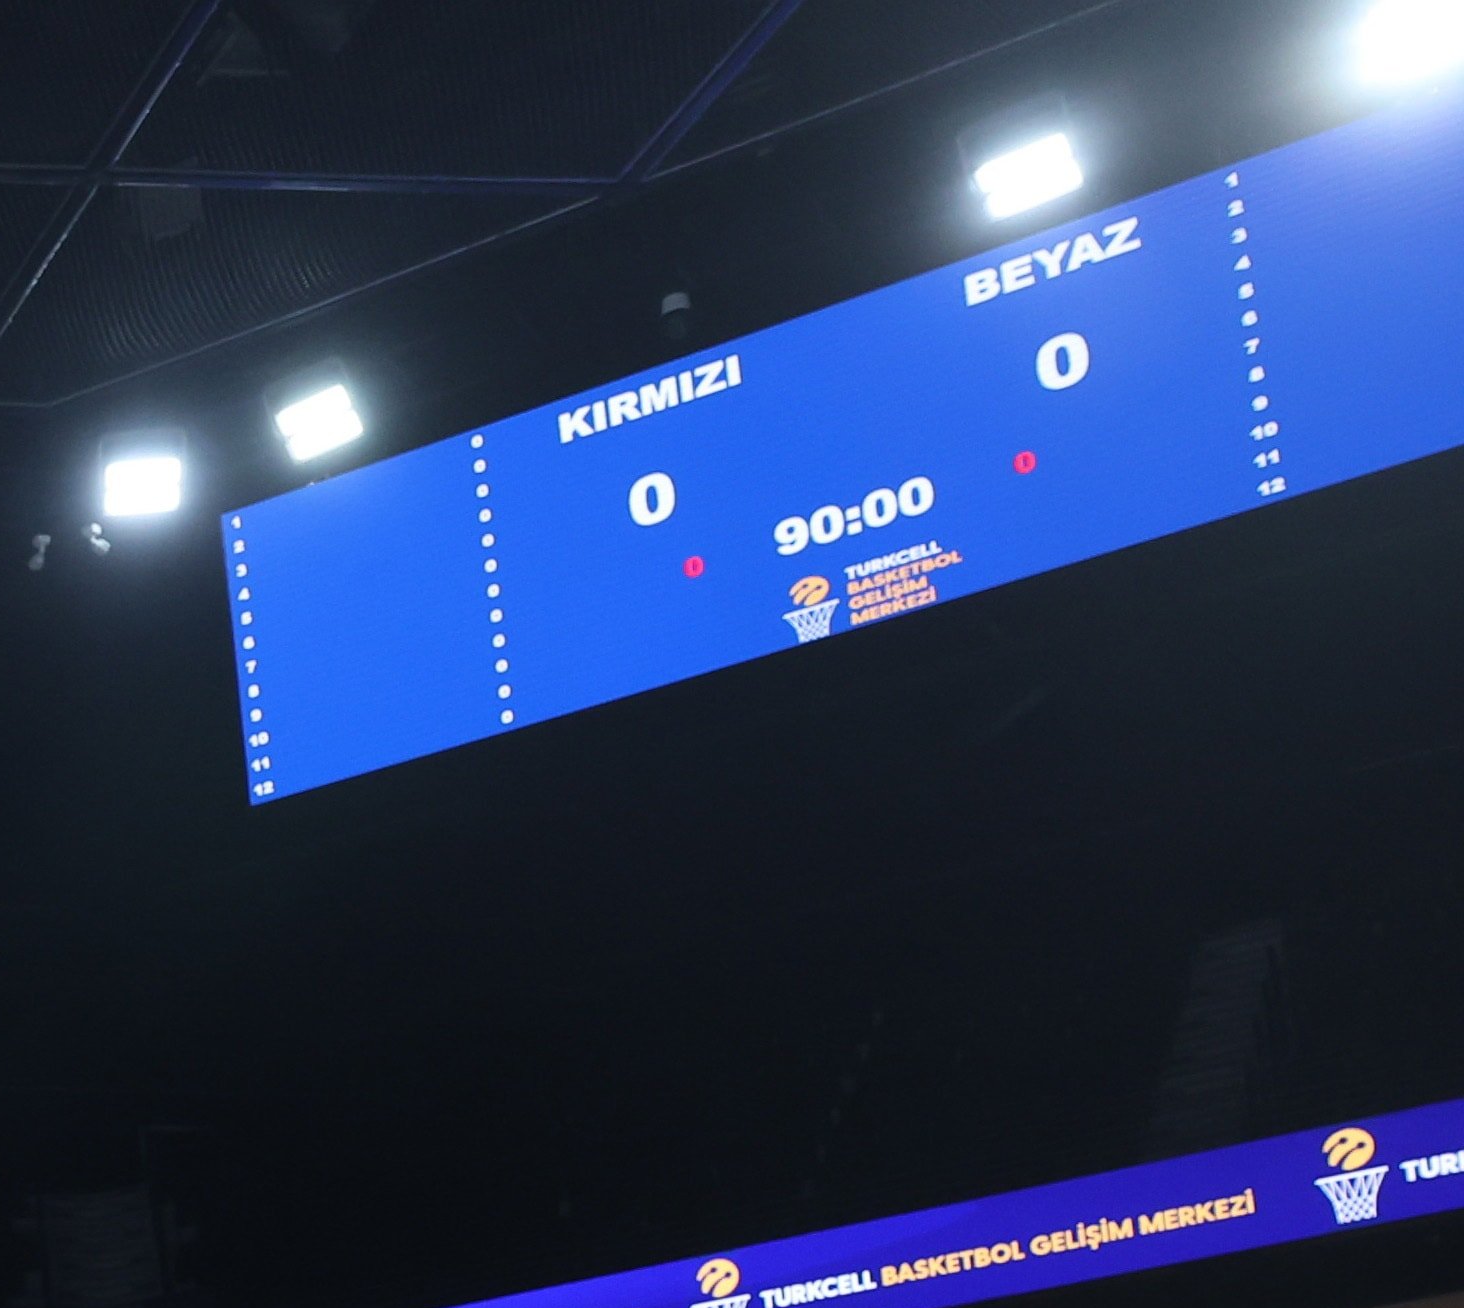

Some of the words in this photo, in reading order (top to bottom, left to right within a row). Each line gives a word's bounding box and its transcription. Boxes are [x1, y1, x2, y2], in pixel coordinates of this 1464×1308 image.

[964, 216, 1142, 306] BEYAZ
[1036, 332, 1090, 390] 0
[558, 354, 742, 443] KIRMIZI
[629, 472, 675, 526] 0
[773, 476, 935, 556] 90:00
[843, 540, 944, 580] TURKCELL
[1399, 1149, 1464, 1183] TUR
[880, 1240, 1026, 1287] BASKETBOL
[1029, 1217, 1135, 1256] GELİŞİM
[1137, 1187, 1256, 1236] MERKEZİ
